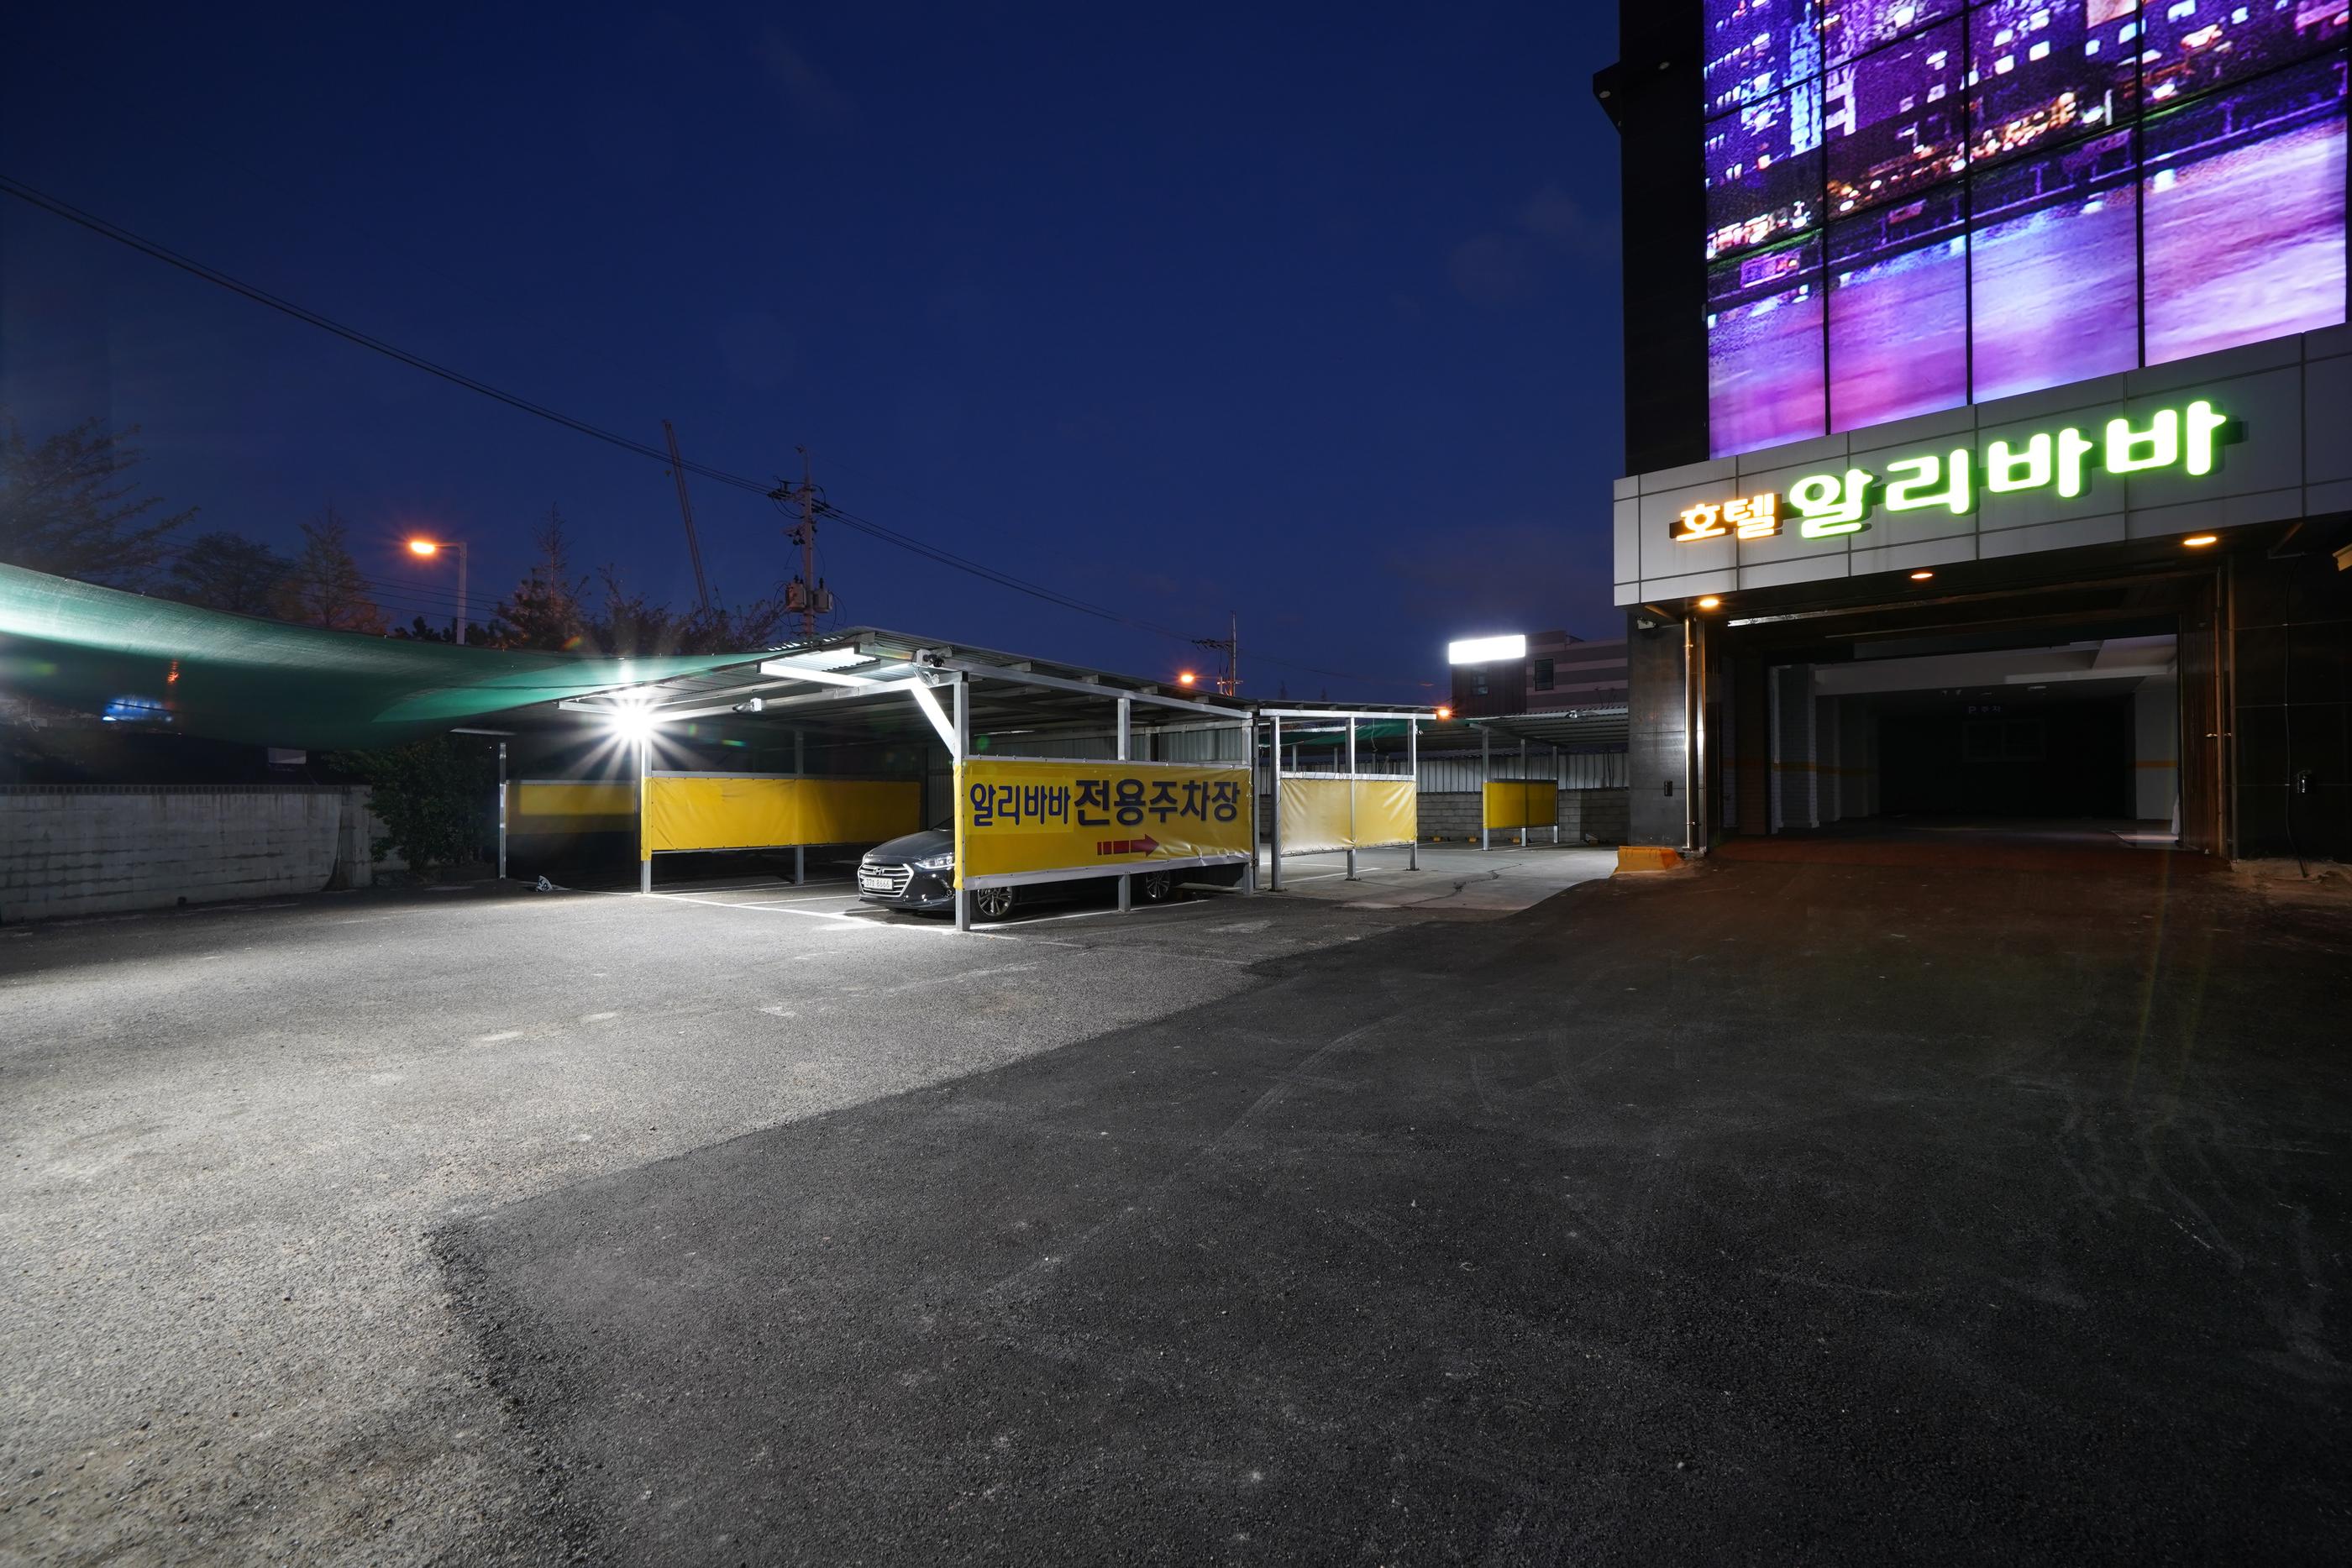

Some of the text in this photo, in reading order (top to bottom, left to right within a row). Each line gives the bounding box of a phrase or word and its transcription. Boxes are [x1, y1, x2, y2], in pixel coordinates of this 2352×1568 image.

[1675, 400, 2227, 543] 호텔 알리바바
[969, 783, 1072, 827] 알리바바
